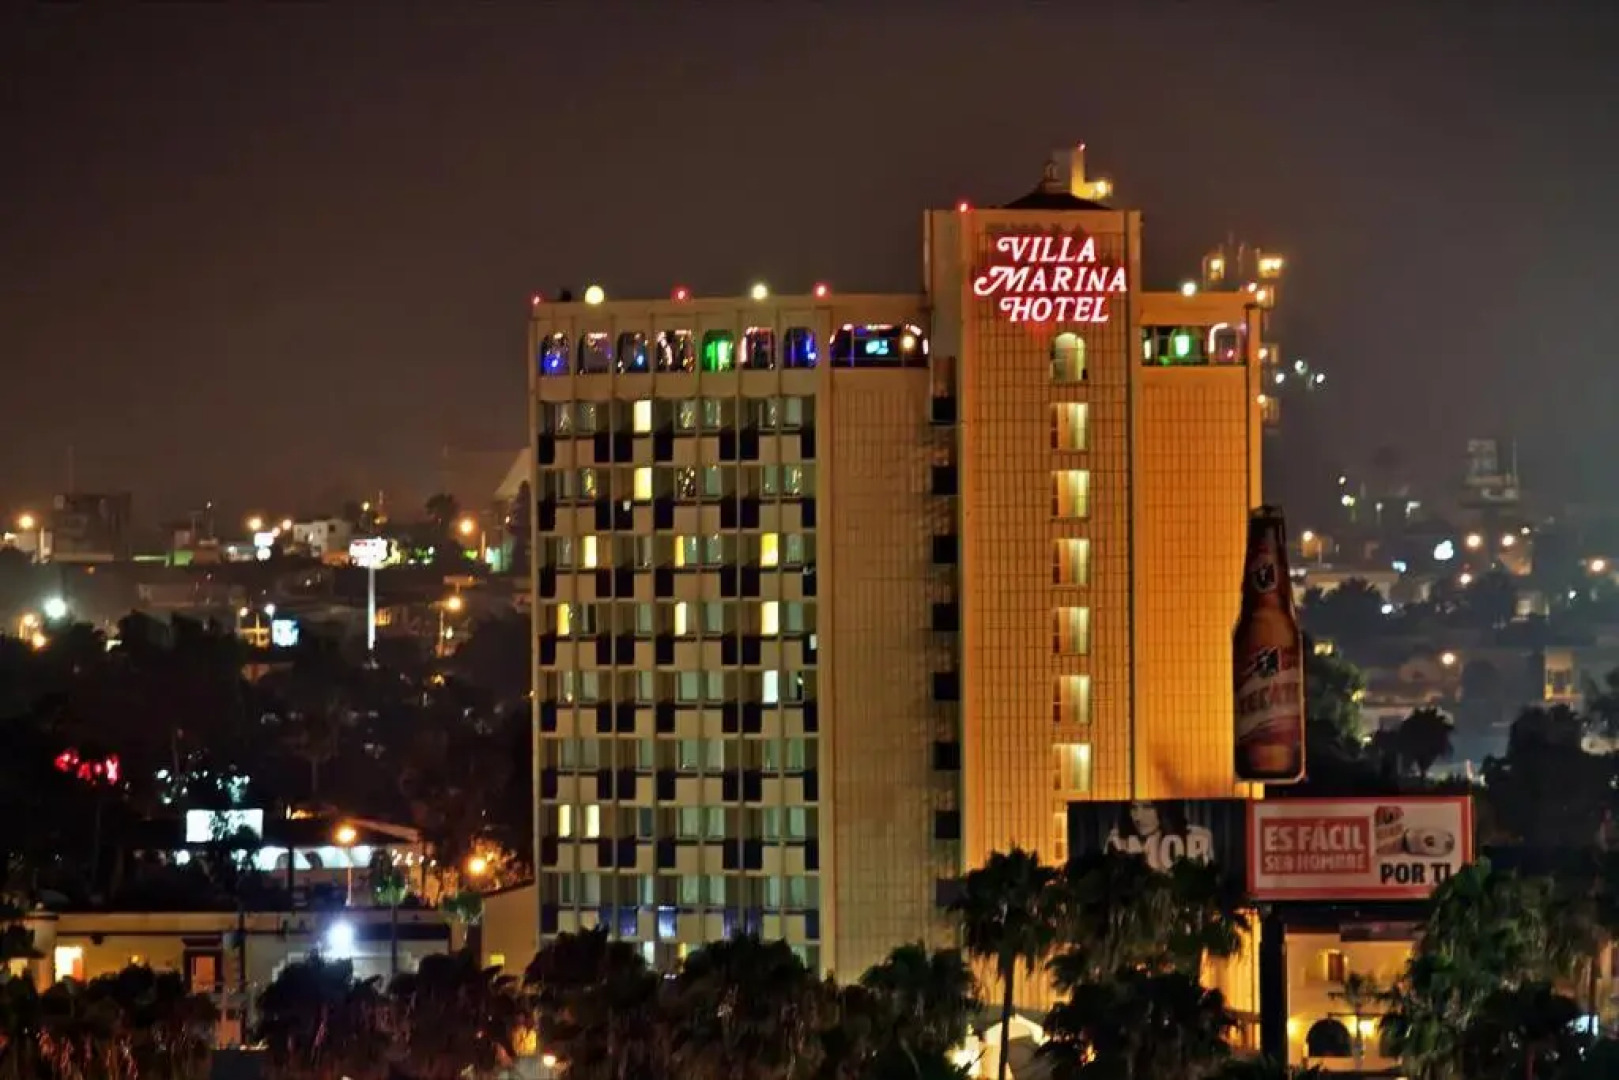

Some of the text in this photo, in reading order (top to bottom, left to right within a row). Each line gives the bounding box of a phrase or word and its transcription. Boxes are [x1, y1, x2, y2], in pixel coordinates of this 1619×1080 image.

[997, 236, 1096, 262] VILLA
[973, 266, 1128, 297] MARINA
[999, 297, 1109, 322] HOTEL
[1264, 826, 1294, 850] ES
[1300, 820, 1367, 851] FÁCIL
[1380, 862, 1451, 884] POR TI
